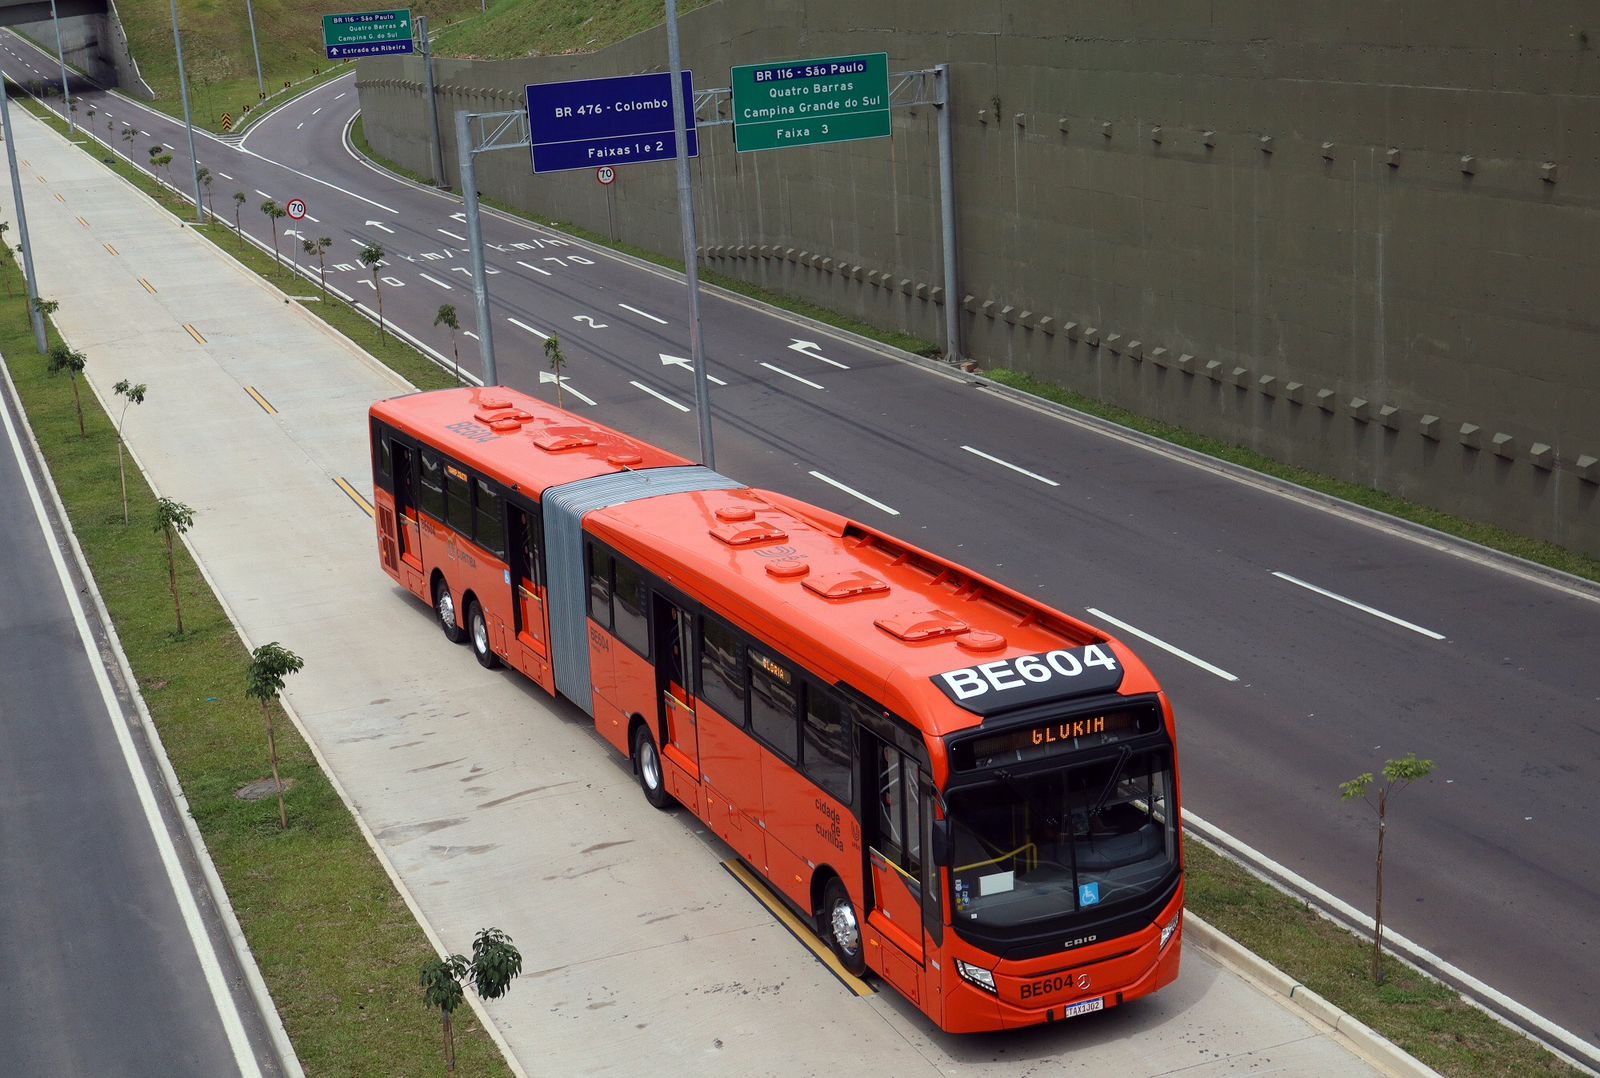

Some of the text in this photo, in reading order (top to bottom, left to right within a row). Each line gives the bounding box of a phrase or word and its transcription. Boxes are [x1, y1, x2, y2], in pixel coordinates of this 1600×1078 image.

[756, 70, 772, 81] BR
[777, 68, 793, 79] 116
[805, 66, 826, 77] São
[830, 62, 864, 74] Paulo
[769, 82, 853, 98] Quatro Barras
[555, 106, 572, 118] BR
[577, 103, 602, 116] 476
[615, 98, 668, 112] Colombo
[744, 95, 880, 118] Campina Grande do Sul
[777, 124, 829, 139] Faixa 3
[588, 145, 630, 158] Faixas
[635, 144, 640, 154] 1
[656, 141, 663, 151] 2
[600, 169, 612, 178] 70
[291, 203, 303, 212] 70
[486, 238, 569, 252] km/h
[543, 255, 596, 267] 70
[357, 277, 405, 290] 70
[572, 315, 608, 328] 2
[941, 644, 1116, 700] BE604
[815, 798, 840, 824] cidade
[831, 821, 840, 837] de
[1064, 935, 1096, 947] CAIO
[1020, 974, 1074, 999] BE604
